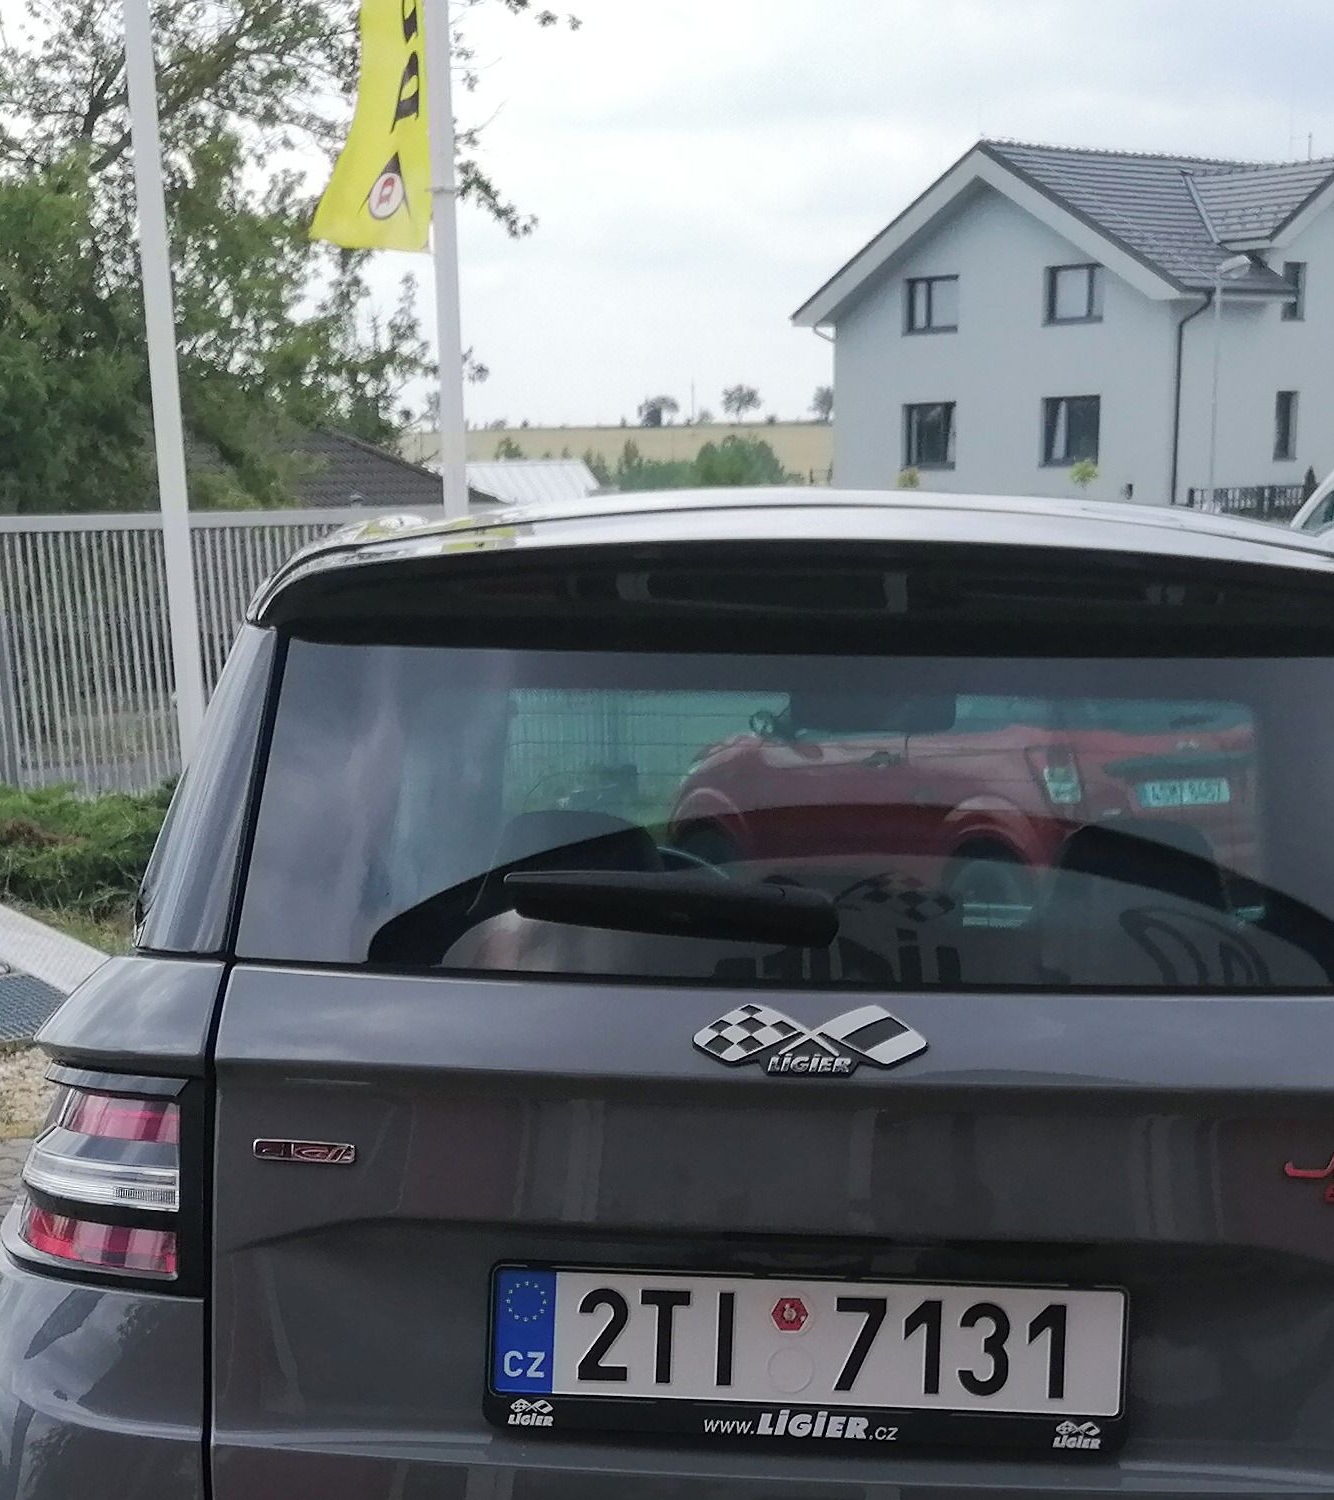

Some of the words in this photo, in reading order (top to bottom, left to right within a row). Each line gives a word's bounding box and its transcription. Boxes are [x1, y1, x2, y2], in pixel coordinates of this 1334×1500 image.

[768, 1053, 852, 1074] LIGIER
[503, 1350, 546, 1379] CZ
[577, 1287, 735, 1387] 2TI
[833, 1296, 1067, 1400] 7131
